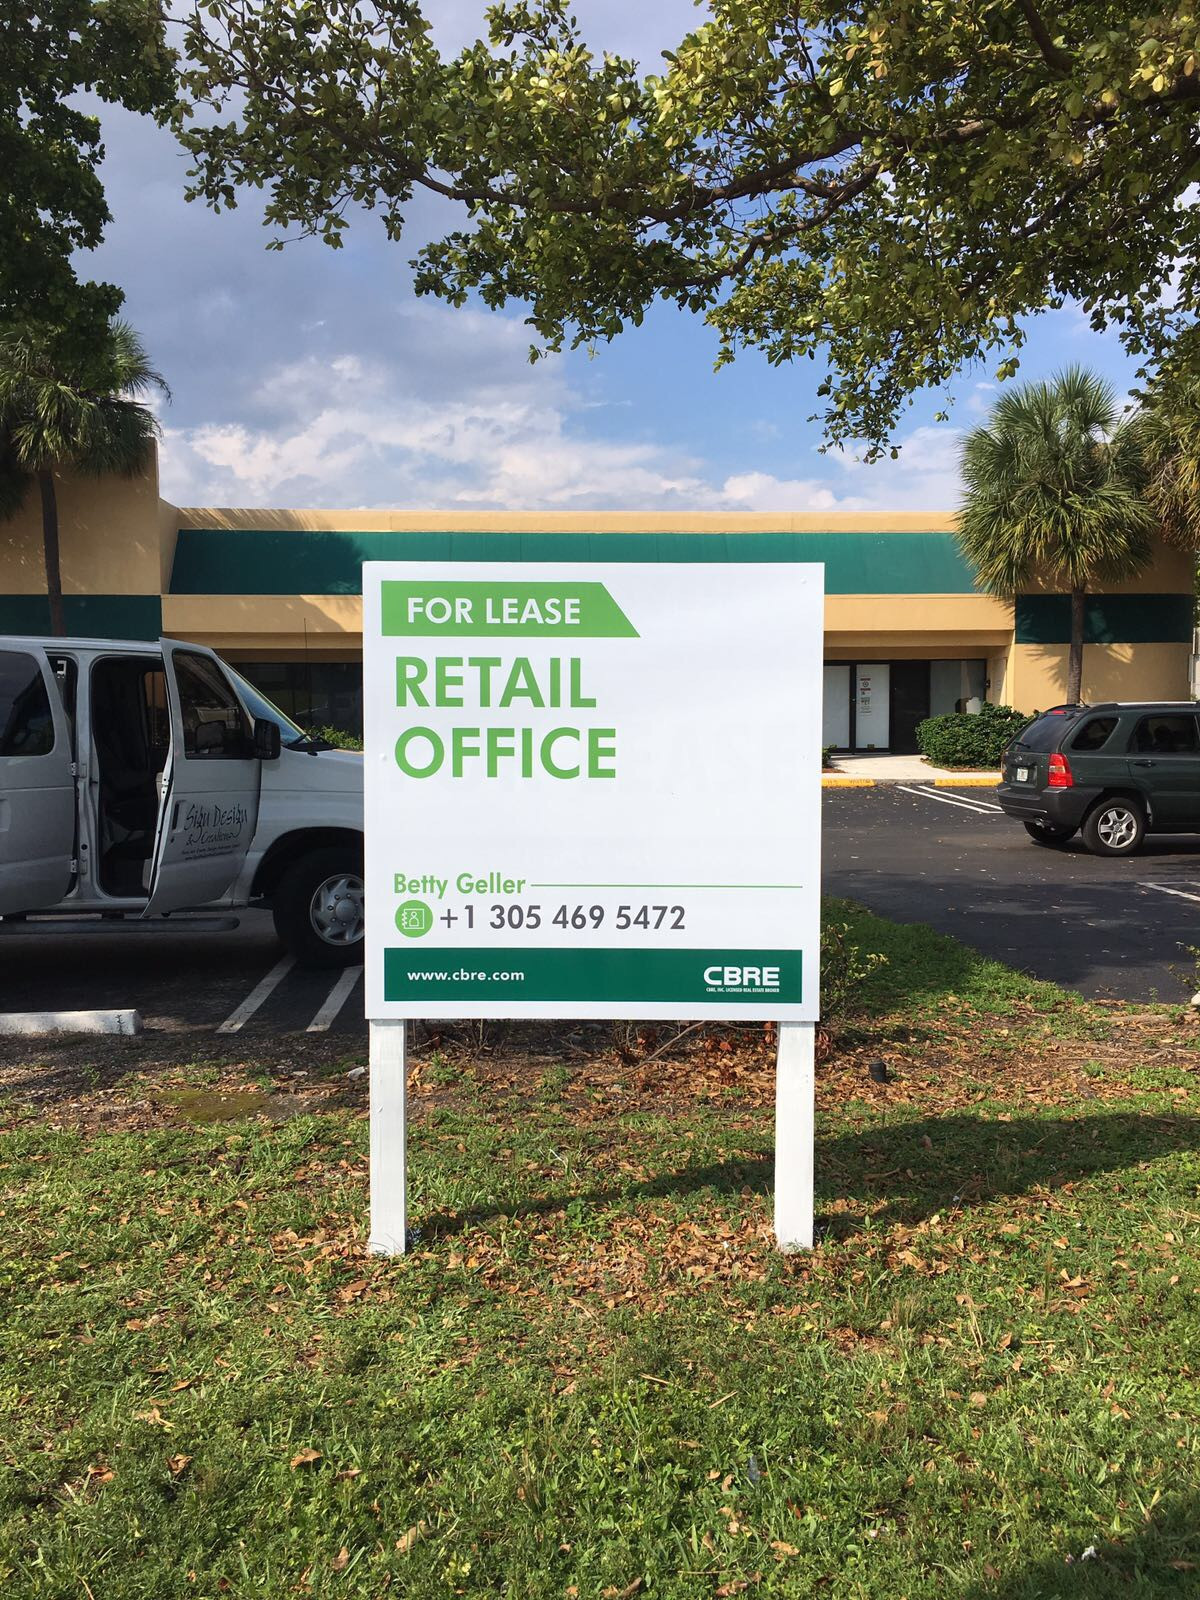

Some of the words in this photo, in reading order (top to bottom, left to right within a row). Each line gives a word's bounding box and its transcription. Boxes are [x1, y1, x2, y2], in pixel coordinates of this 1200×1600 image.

[407, 597, 473, 624] FOR
[485, 598, 581, 625] LEASE
[395, 656, 597, 708] RETAIL
[395, 726, 617, 779] OFFICE
[184, 804, 210, 842] Sign
[213, 803, 248, 838] Design
[394, 872, 448, 899] Betty
[456, 872, 526, 895] Geller
[439, 905, 474, 929] +1
[489, 905, 541, 929] 305
[551, 905, 605, 930] 469
[615, 905, 685, 930] 5472
[407, 969, 525, 981] www.cbre.com
[703, 966, 780, 986] CBRE
